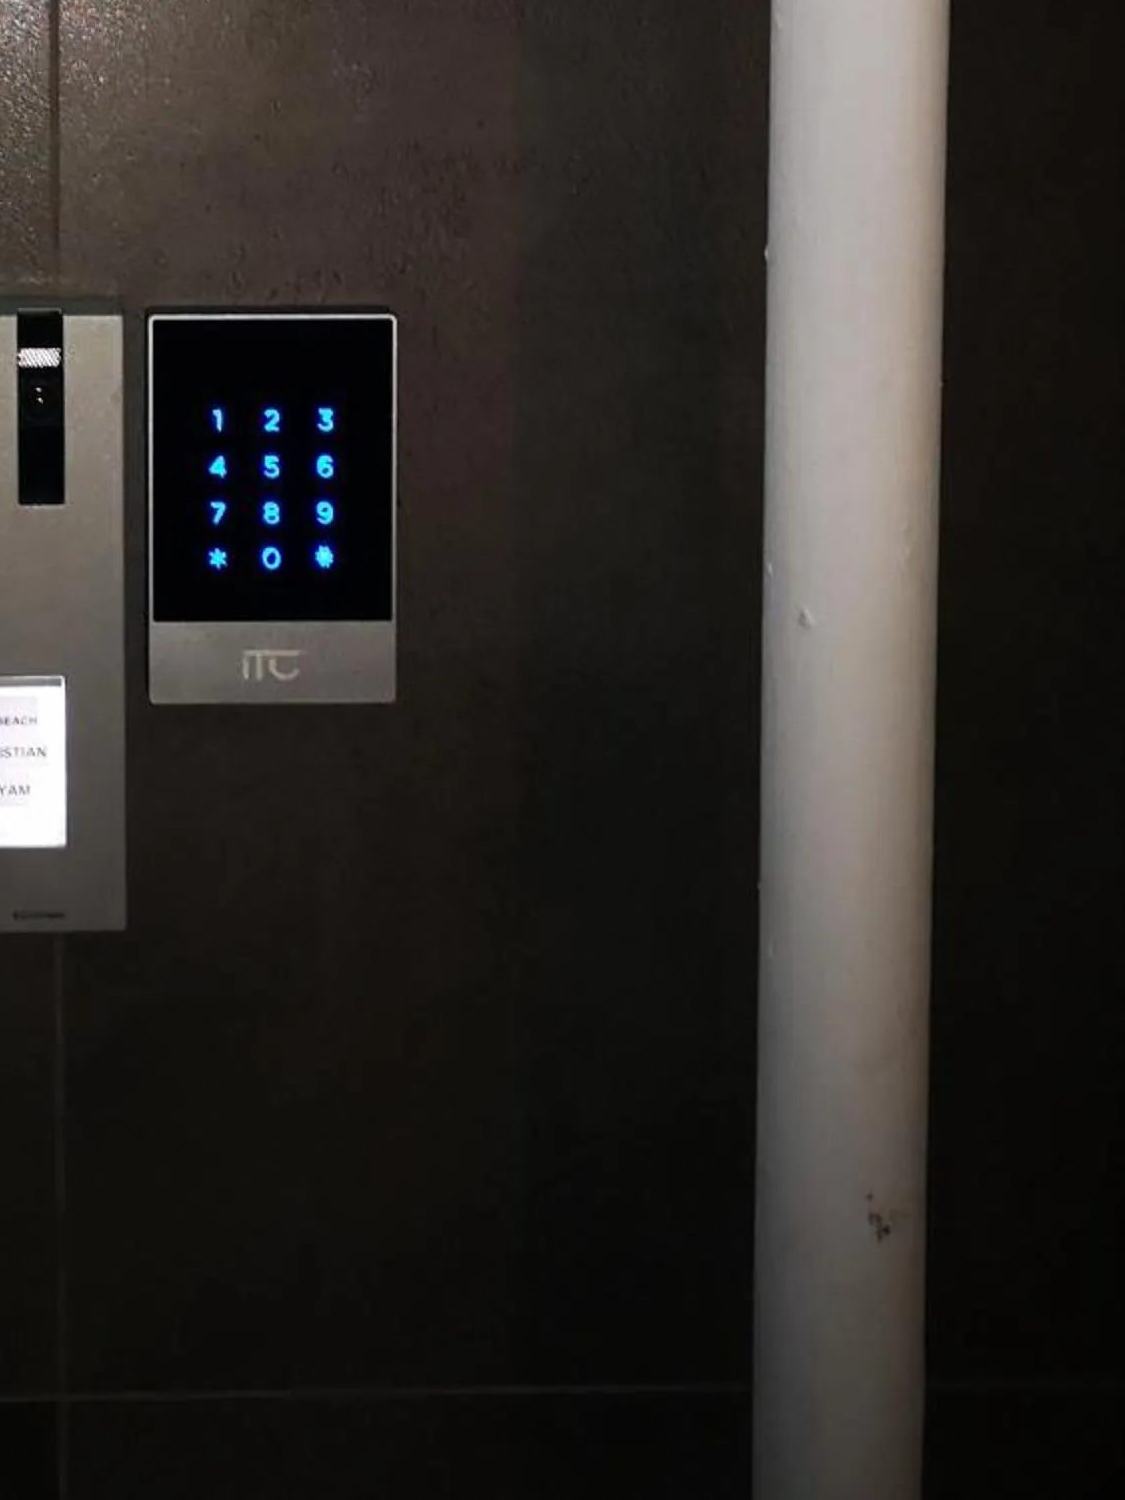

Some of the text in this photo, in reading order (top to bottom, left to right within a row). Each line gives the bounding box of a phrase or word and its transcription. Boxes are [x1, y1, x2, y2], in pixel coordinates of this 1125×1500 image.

[212, 407, 334, 433] 1 2 3
[208, 453, 334, 479] 4 5 6
[210, 500, 334, 525] 7 8 9
